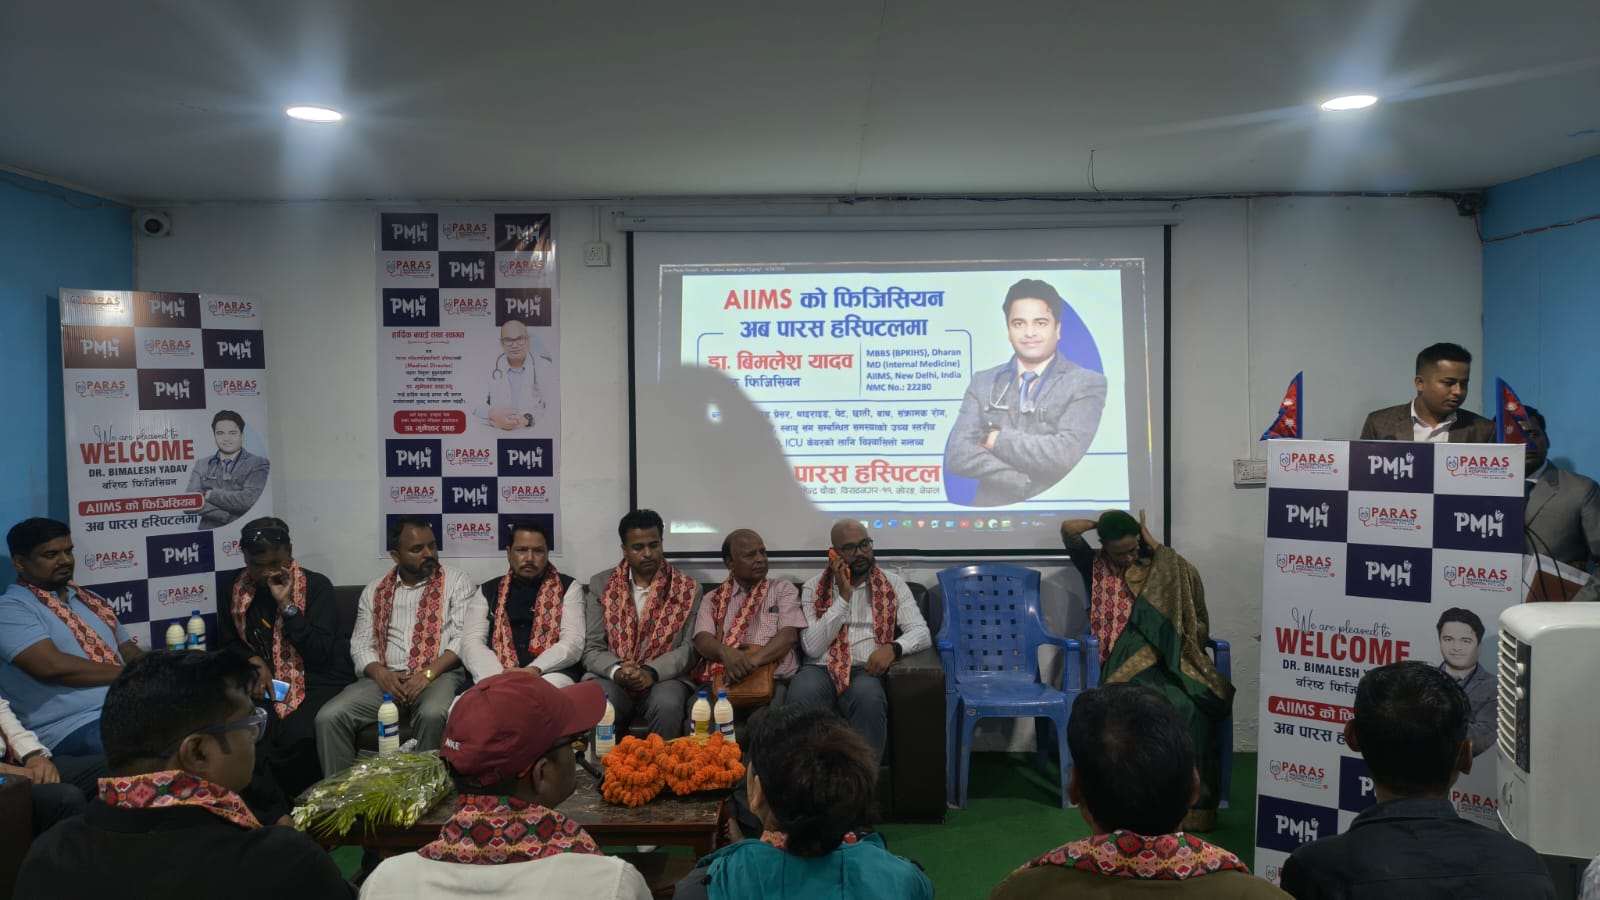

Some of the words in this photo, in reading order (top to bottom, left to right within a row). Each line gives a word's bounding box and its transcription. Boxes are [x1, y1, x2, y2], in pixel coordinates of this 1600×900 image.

[392, 221, 428, 244] PMH
[452, 223, 488, 232] PARAS
[395, 260, 432, 269] PARAS
[449, 258, 485, 282] PMH
[509, 260, 544, 270] PARAS
[218, 301, 252, 310] PARAS
[390, 295, 426, 318] PMH
[453, 298, 488, 307] PARAS
[504, 295, 541, 317] PMH
[723, 288, 792, 310] AIIMS
[800, 287, 827, 308] को
[833, 286, 945, 309] फिजिसियन
[740, 320, 771, 338] अब
[778, 320, 825, 338] पारस
[830, 314, 928, 338] हस्पिटलमा
[80, 338, 120, 358] PMH
[154, 340, 191, 348] PARAS
[216, 340, 252, 359] PMH
[866, 349, 890, 357] MBBS
[932, 348, 961, 356] Dharan
[737, 350, 803, 370] बिमलेश
[808, 354, 854, 370] यादव
[883, 360, 917, 369] (Internal
[919, 359, 960, 368] Medicine)
[223, 380, 257, 388] PARAS
[745, 375, 801, 388] फिजिसियन
[866, 372, 893, 380] AIIMS,
[915, 371, 939, 380] Delhi,
[86, 381, 125, 389] PARAS
[153, 379, 190, 400] PMH
[785, 438, 803, 447] ICU
[80, 439, 194, 464] WELCOME
[396, 447, 432, 469] PMH
[456, 449, 490, 457] PARAS
[507, 447, 543, 469] PMH
[1291, 453, 1335, 464] PARAS
[1368, 452, 1414, 480] PMH
[1460, 456, 1509, 467] PARAS
[89, 468, 105, 477] DR.
[108, 466, 156, 477] BIMALESH
[159, 464, 188, 473] YADAV
[794, 465, 849, 484] पारस
[855, 458, 941, 484] हस्पिटल
[102, 479, 128, 490] वरिष्ठ
[400, 486, 435, 494] PARAS
[511, 486, 546, 494] PARAS
[452, 484, 487, 507] PMH
[86, 501, 122, 513] AIIMS
[125, 501, 138, 511] को
[142, 497, 196, 510] फिजिसियन
[1372, 507, 1417, 519] PARAS
[85, 521, 105, 532] अब
[108, 518, 138, 530] पारस
[141, 514, 198, 528] हस्पिटलमा
[1286, 502, 1330, 528] PMH
[456, 523, 491, 531] PARAS
[1453, 509, 1504, 539] PMH
[96, 550, 134, 561] PARAS
[162, 542, 199, 566] PMH
[1289, 554, 1331, 567] PARAS
[1365, 559, 1412, 588] PMH
[1458, 566, 1507, 580] PARAS
[168, 585, 205, 597] PARAS
[106, 592, 132, 615] MH
[1291, 607, 1317, 634] We
[1319, 624, 1336, 632] are
[1338, 620, 1379, 638] pleased
[1380, 622, 1392, 637] to
[1276, 627, 1410, 666] WELCOME
[1282, 659, 1300, 671] DR.
[1304, 662, 1359, 678] BIMALESH
[1296, 676, 1325, 690] वरिष्ठ
[1275, 700, 1315, 717] AIIMS
[1320, 707, 1336, 720] को
[1274, 722, 1295, 735] अब
[1299, 725, 1333, 742] पारस
[1282, 761, 1325, 778] PARAS
[1275, 814, 1319, 843] PMH
